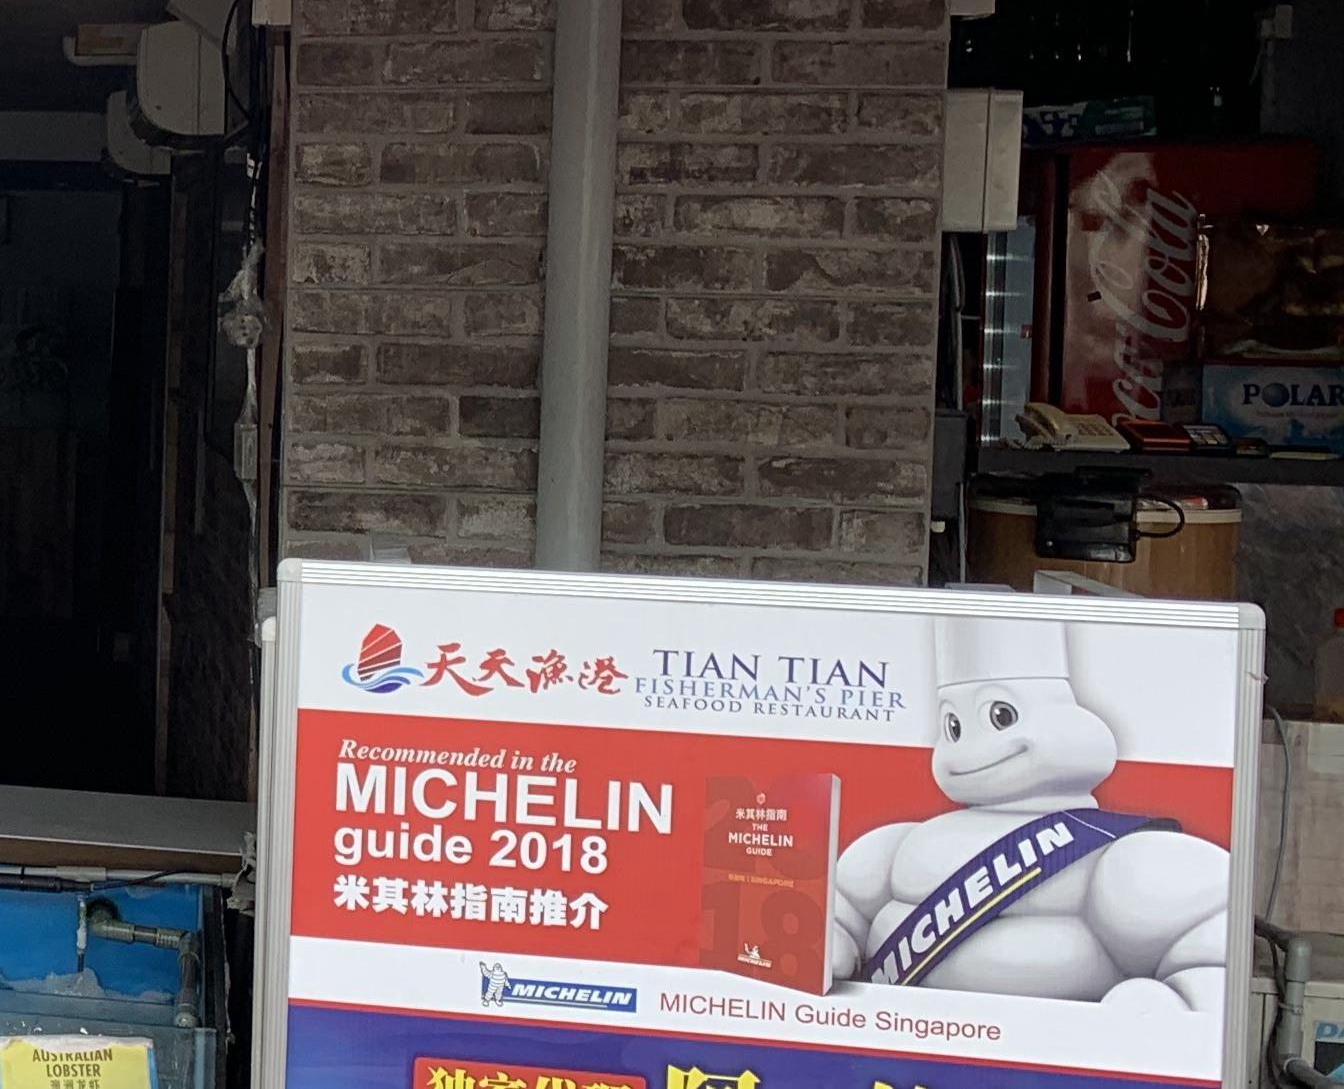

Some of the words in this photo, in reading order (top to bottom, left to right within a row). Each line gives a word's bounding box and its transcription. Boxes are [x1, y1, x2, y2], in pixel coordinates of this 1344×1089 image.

[653, 649, 762, 681] TIAN
[778, 655, 889, 688] TIAN
[635, 677, 826, 704] FISHERMAN'S
[841, 689, 906, 708] PIER
[644, 695, 742, 713] SEAFOOD
[754, 702, 896, 721] RESTAURANT
[339, 739, 506, 769] Recommended
[511, 750, 533, 770] in
[541, 753, 577, 773] the
[336, 762, 672, 834] MICHELIN
[728, 832, 793, 847] MICHELIN
[752, 823, 768, 831] THE
[334, 822, 472, 866] guide
[489, 829, 608, 874] 2018
[746, 847, 772, 856] GUIDE
[334, 874, 609, 930] 米其林指南推介
[871, 822, 1074, 985] MICHELIN
[512, 984, 633, 1005] MICHELIN
[661, 992, 786, 1021] MICHELIN
[795, 1005, 866, 1028] Guide
[876, 1011, 1002, 1041] Singapore
[46, 1064, 101, 1077] LOBSTER
